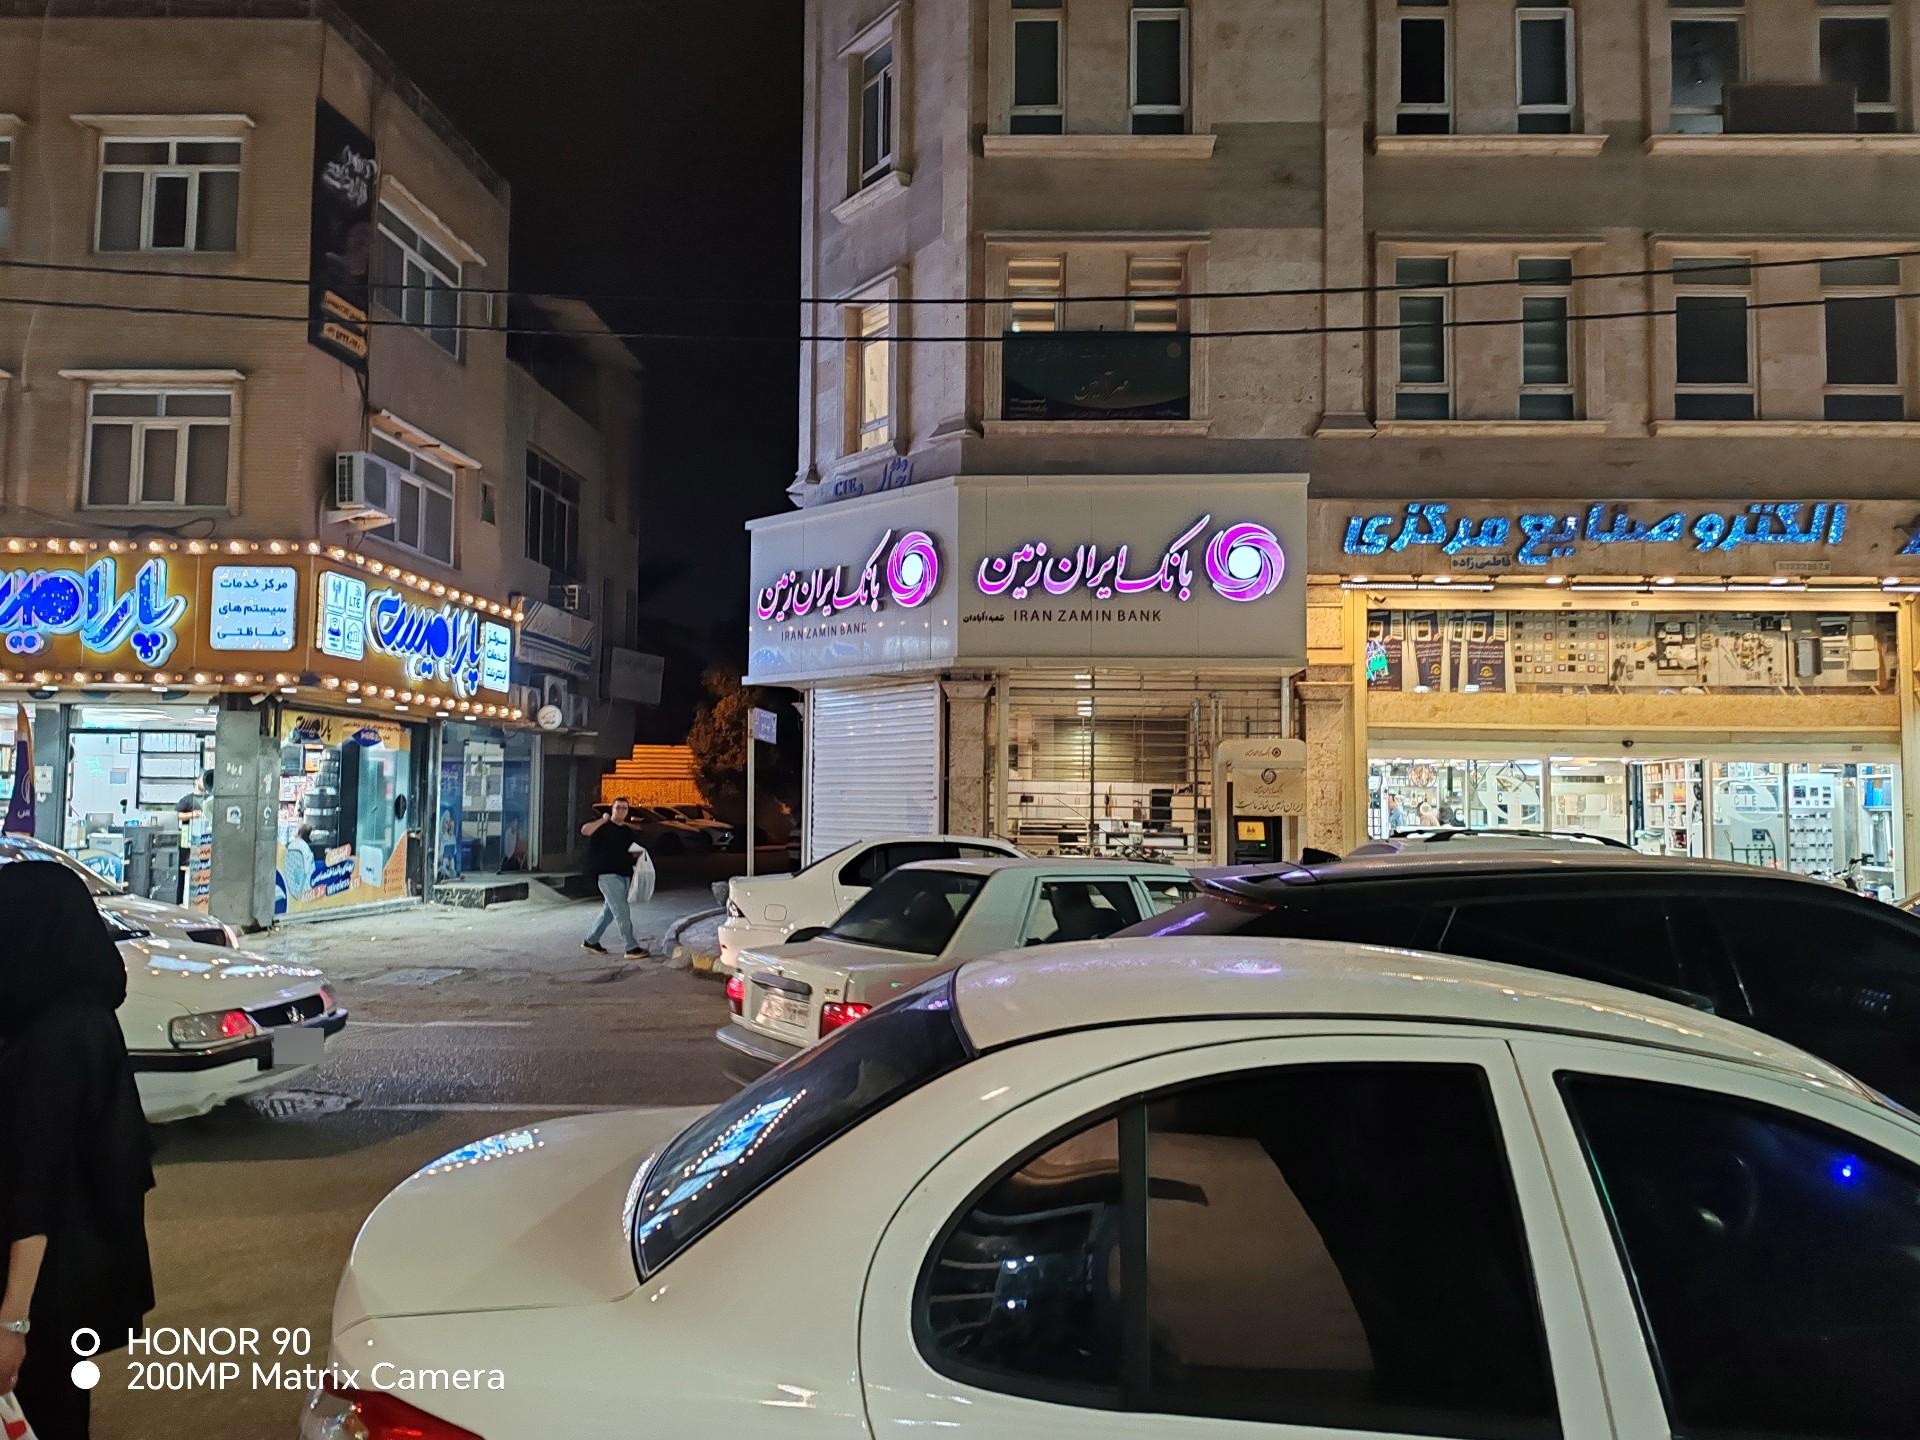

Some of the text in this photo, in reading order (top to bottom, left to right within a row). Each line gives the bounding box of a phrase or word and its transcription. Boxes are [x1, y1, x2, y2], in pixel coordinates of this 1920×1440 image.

[1342, 503, 1511, 556] مرکزی
[1693, 503, 1849, 552] الکترو
[220, 578, 288, 592] مرکز خدمات
[218, 602, 287, 616] سیستم های
[1013, 609, 1161, 622] IRAN ZAMIN BANK
[217, 626, 286, 639] حفاظتی
[780, 622, 868, 642] IRAN ZAMIN BANK
